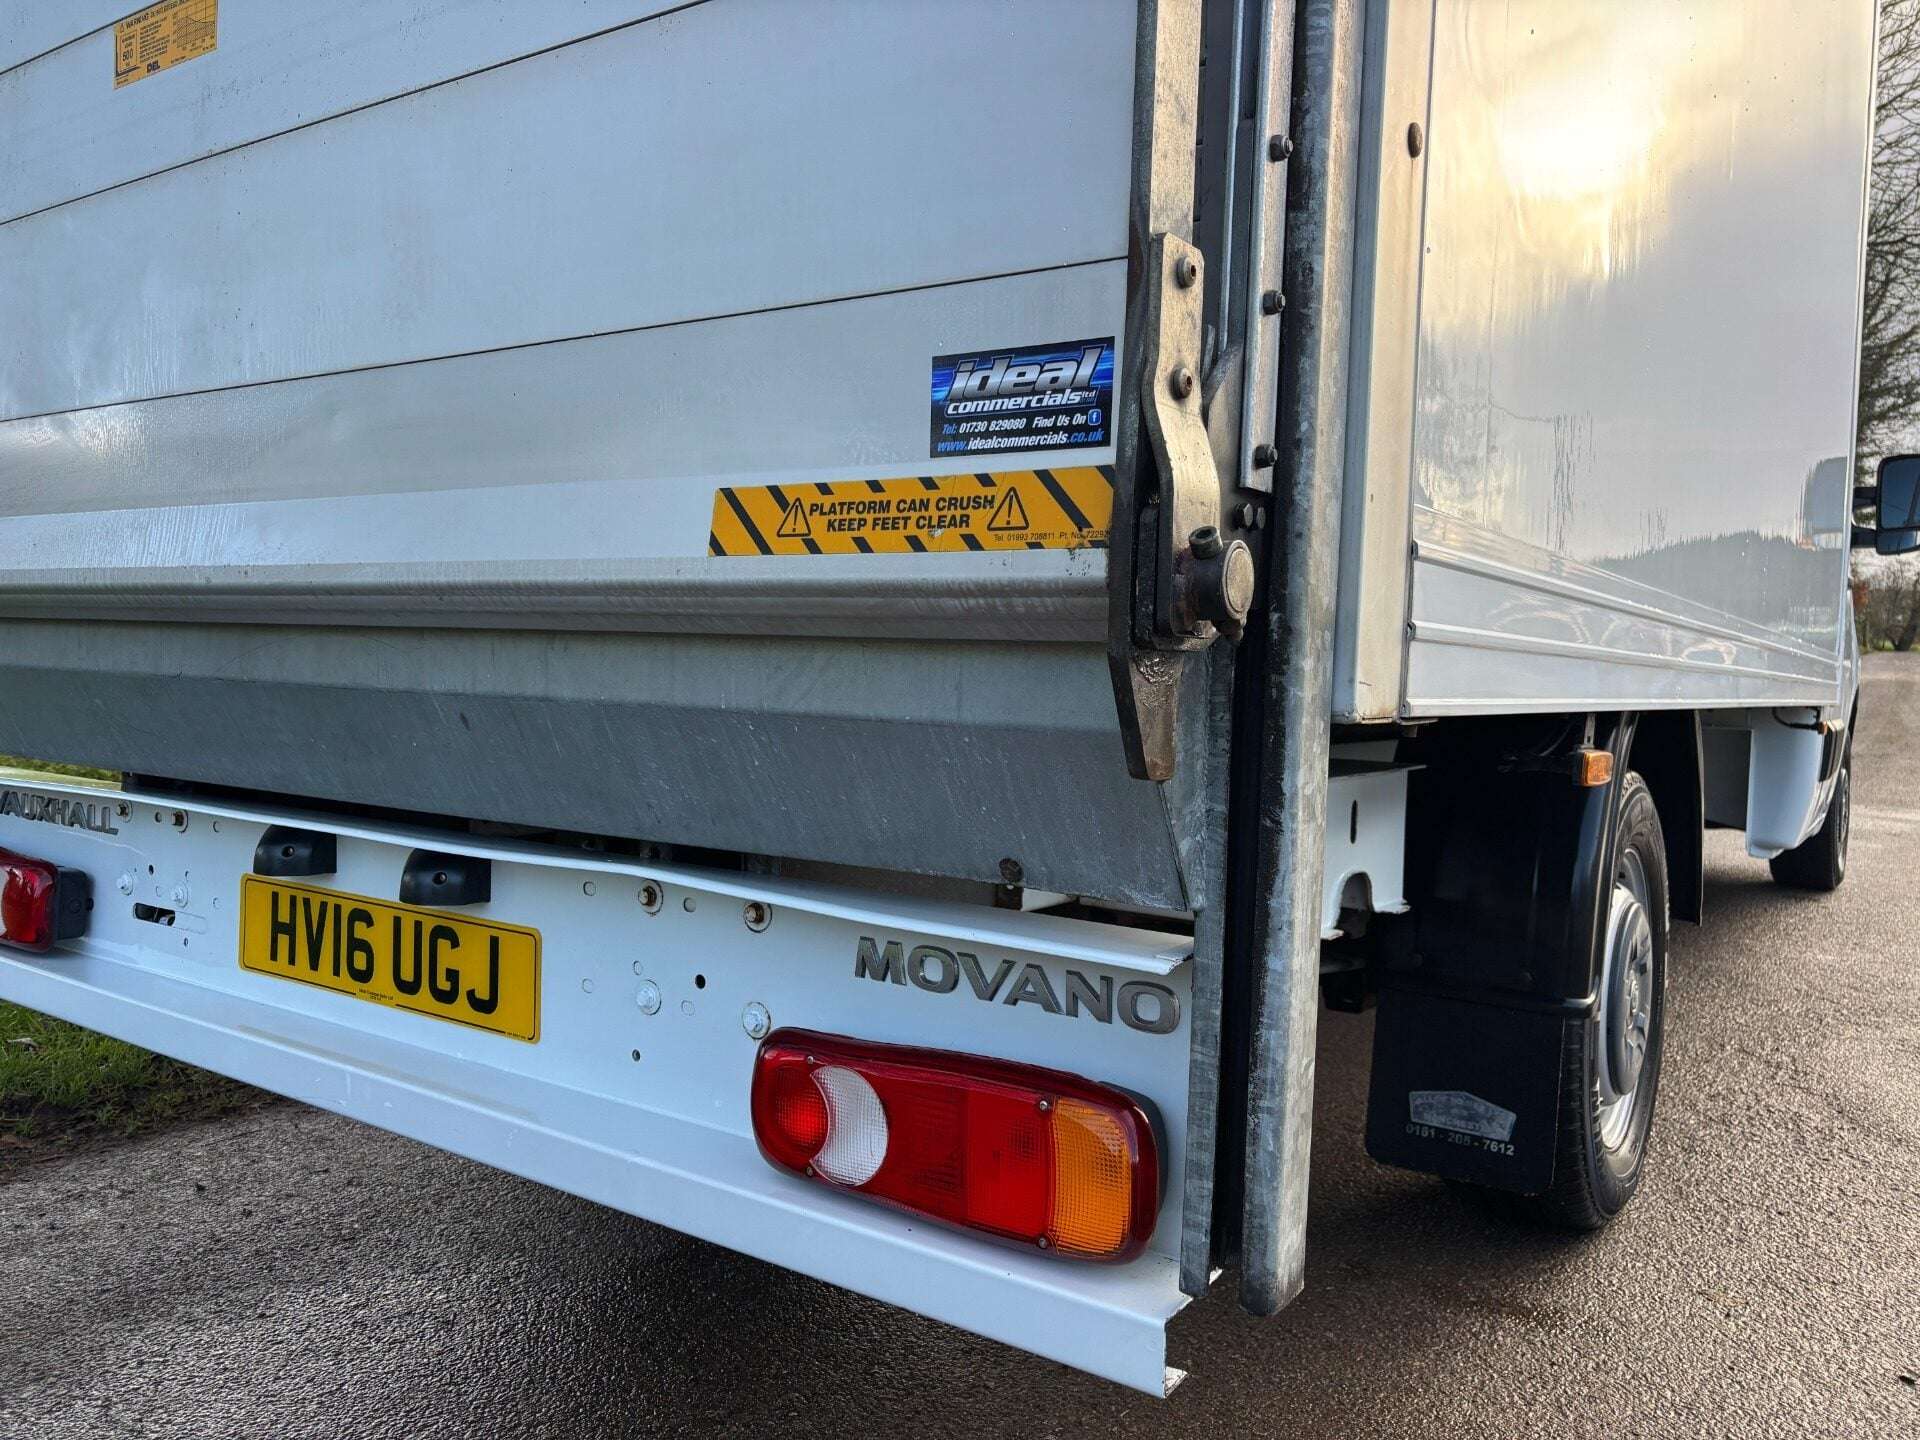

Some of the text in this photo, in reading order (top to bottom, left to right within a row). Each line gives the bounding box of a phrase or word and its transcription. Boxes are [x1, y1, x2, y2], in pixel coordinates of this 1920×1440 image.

[947, 345, 1106, 401] ideal
[947, 389, 1082, 415] commercials
[959, 420, 986, 433] 01730
[988, 417, 1027, 432] 829080
[1032, 415, 1053, 428] Find
[1057, 415, 1069, 427] Us
[1072, 413, 1087, 425] On
[937, 428, 1104, 453] www.idealcommercials.co.uk
[809, 494, 996, 517] PLATFORM CAN CRUSH
[826, 513, 971, 533] KEEP FEET CLEAR
[269, 890, 500, 1015] HV16 UGJ
[854, 935, 1182, 1035] MOVANO
[1483, 1139, 1515, 1156] 7612
